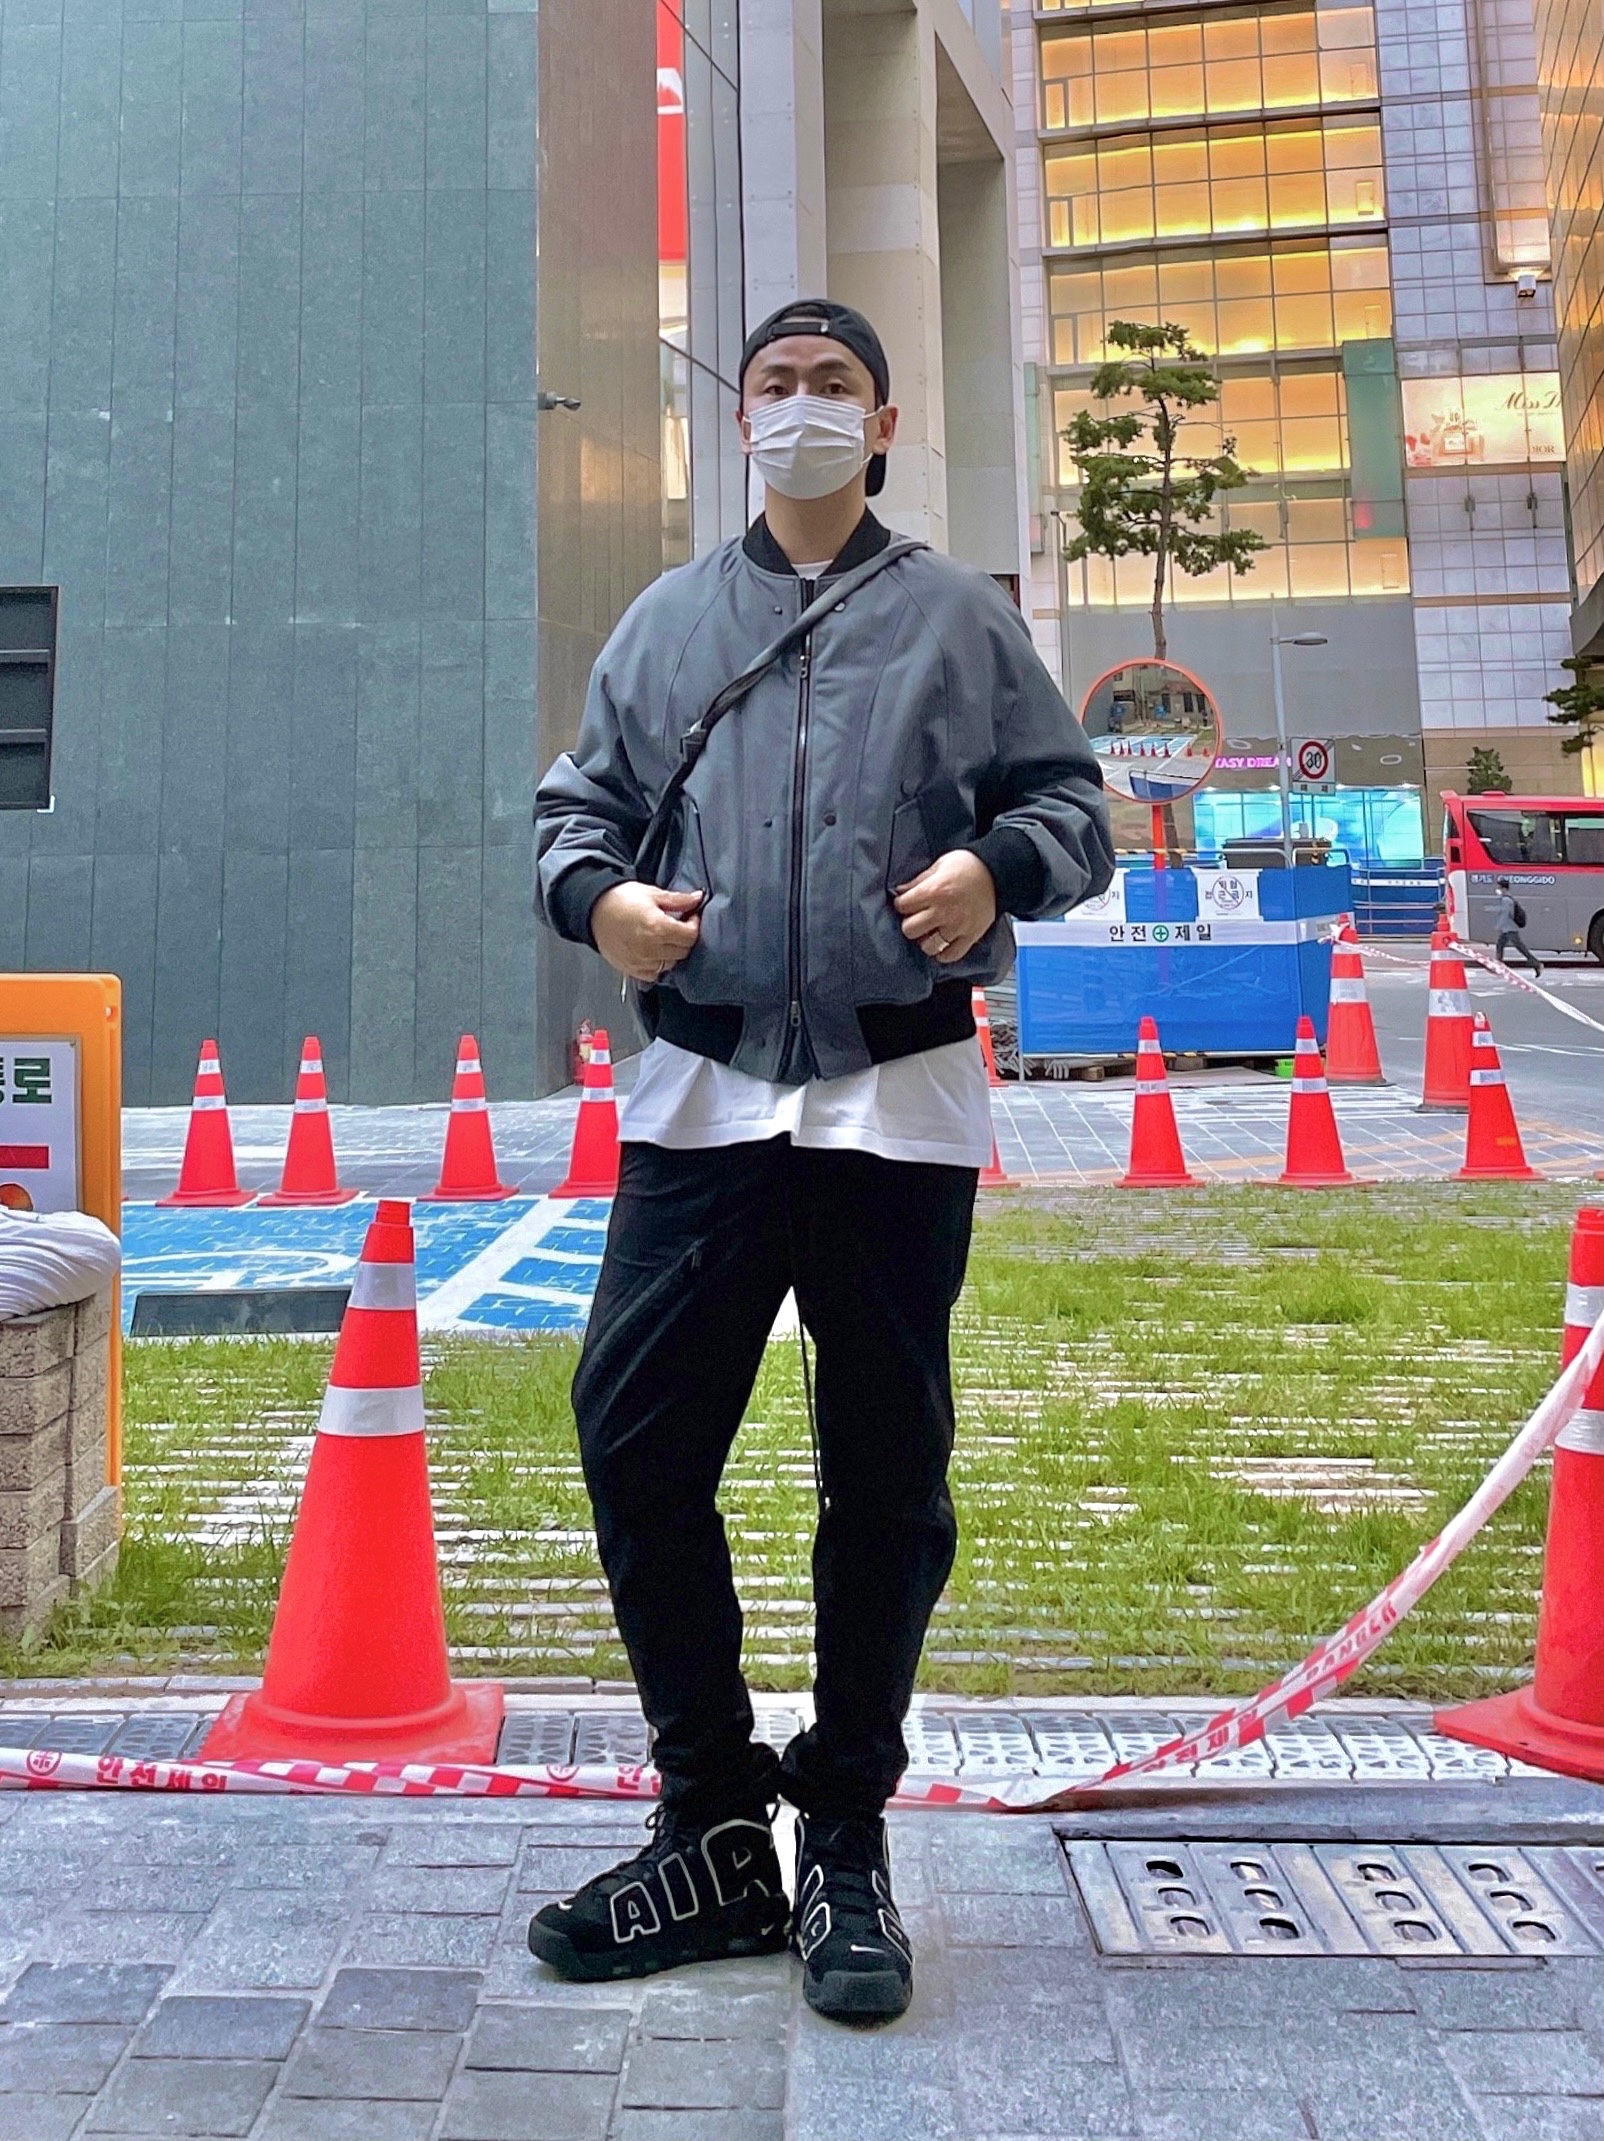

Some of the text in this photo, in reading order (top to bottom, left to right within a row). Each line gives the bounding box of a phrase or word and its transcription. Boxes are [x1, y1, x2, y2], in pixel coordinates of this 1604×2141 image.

[1306, 751, 1321, 769] 30
[1109, 923, 1211, 942] 안전 제일
[0, 1057, 52, 1104] 로
[610, 1819, 776, 1943] AIR
